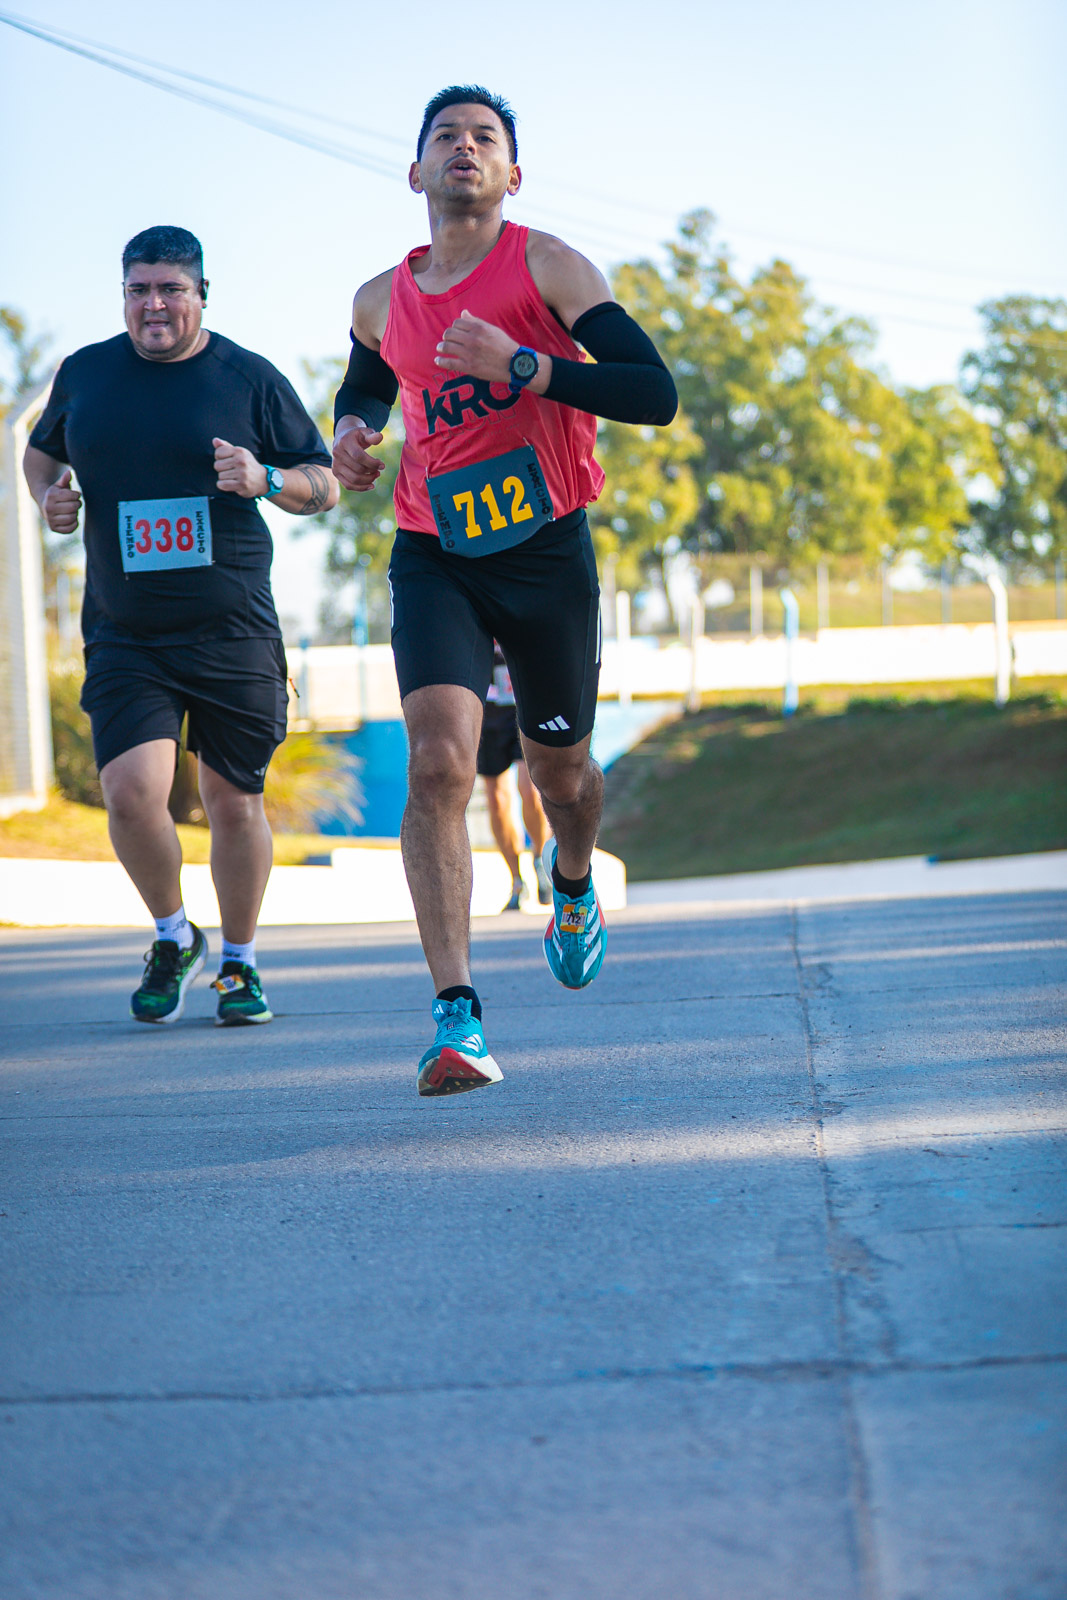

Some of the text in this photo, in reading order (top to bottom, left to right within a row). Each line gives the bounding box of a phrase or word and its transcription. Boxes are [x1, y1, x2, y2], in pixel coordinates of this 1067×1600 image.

[452, 476, 534, 538] 712
[125, 515, 134, 558] TIEMPO
[134, 516, 194, 554] 338
[195, 511, 205, 553] EXACTO
